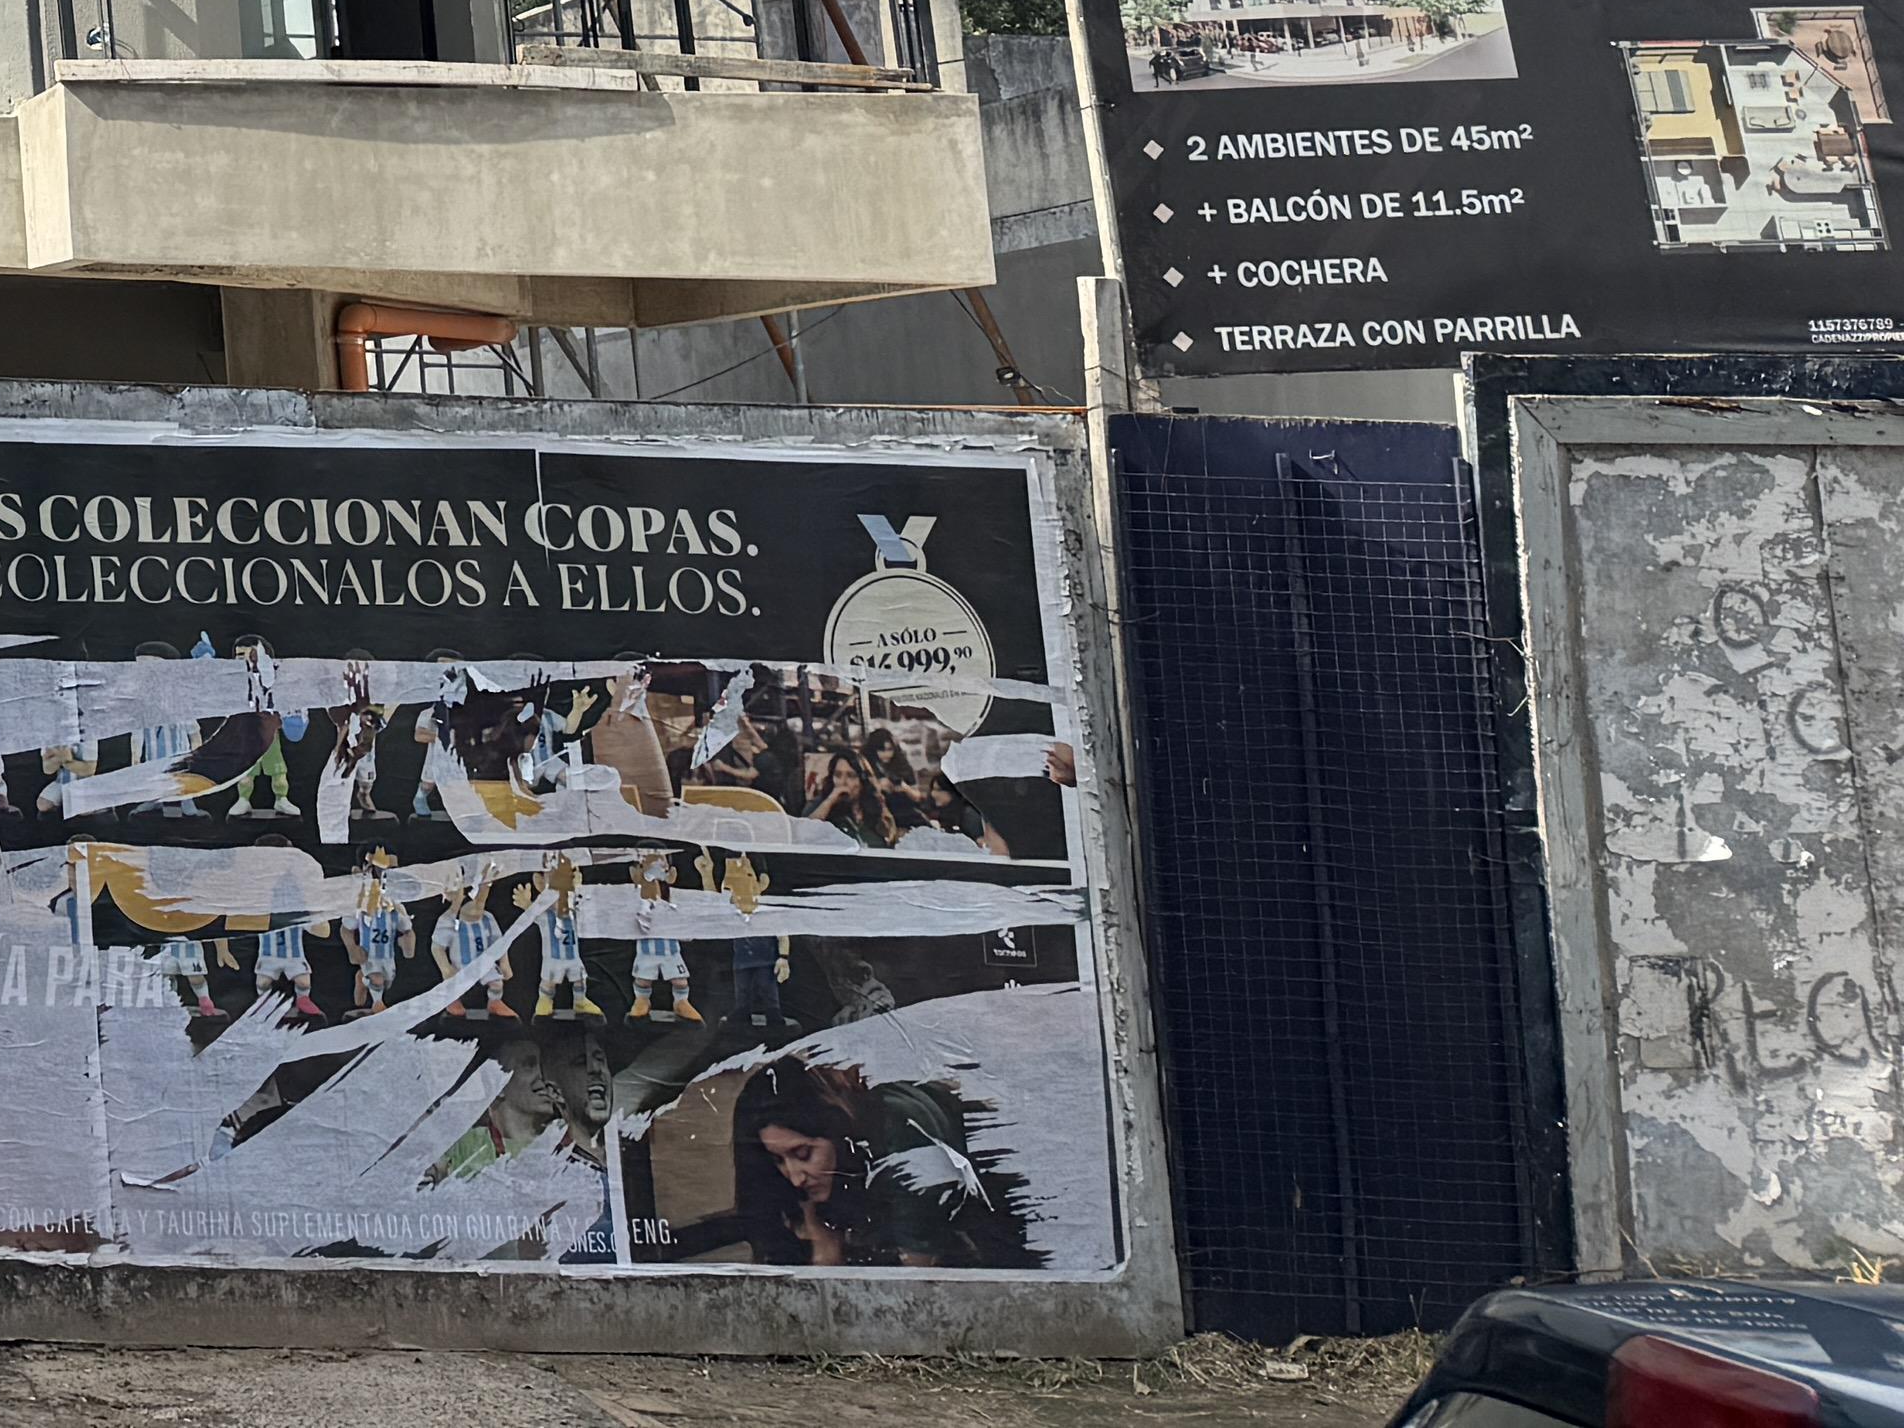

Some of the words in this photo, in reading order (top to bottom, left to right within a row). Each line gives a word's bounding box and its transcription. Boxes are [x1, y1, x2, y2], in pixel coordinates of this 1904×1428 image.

[1186, 135, 1209, 162] 2
[1217, 128, 1393, 161] AMBIENTES
[1399, 126, 1444, 153] DE
[1226, 189, 1353, 224] BALCÓN
[1360, 191, 1405, 220] DE
[1236, 257, 1389, 288] COCHERA
[1214, 322, 1356, 352] TERRAZA
[1361, 319, 1426, 347] CON
[1432, 313, 1582, 343] PARRILLA
[1808, 318, 1894, 332] 1157376789
[38, 493, 508, 548] COLECCIONAN
[524, 500, 760, 559] COPAS.
[500, 558, 539, 608] A
[558, 564, 762, 616] ELLOS.
[877, 633, 888, 648] A
[889, 627, 937, 647] SÓLO
[371, 928, 389, 944] 26
[45, 942, 172, 1008] PARA
[136, 1210, 149, 1236] Y
[156, 1210, 245, 1237] TAURINA
[251, 1210, 414, 1241] SUPLEMENTADA
[419, 1213, 460, 1241] CON
